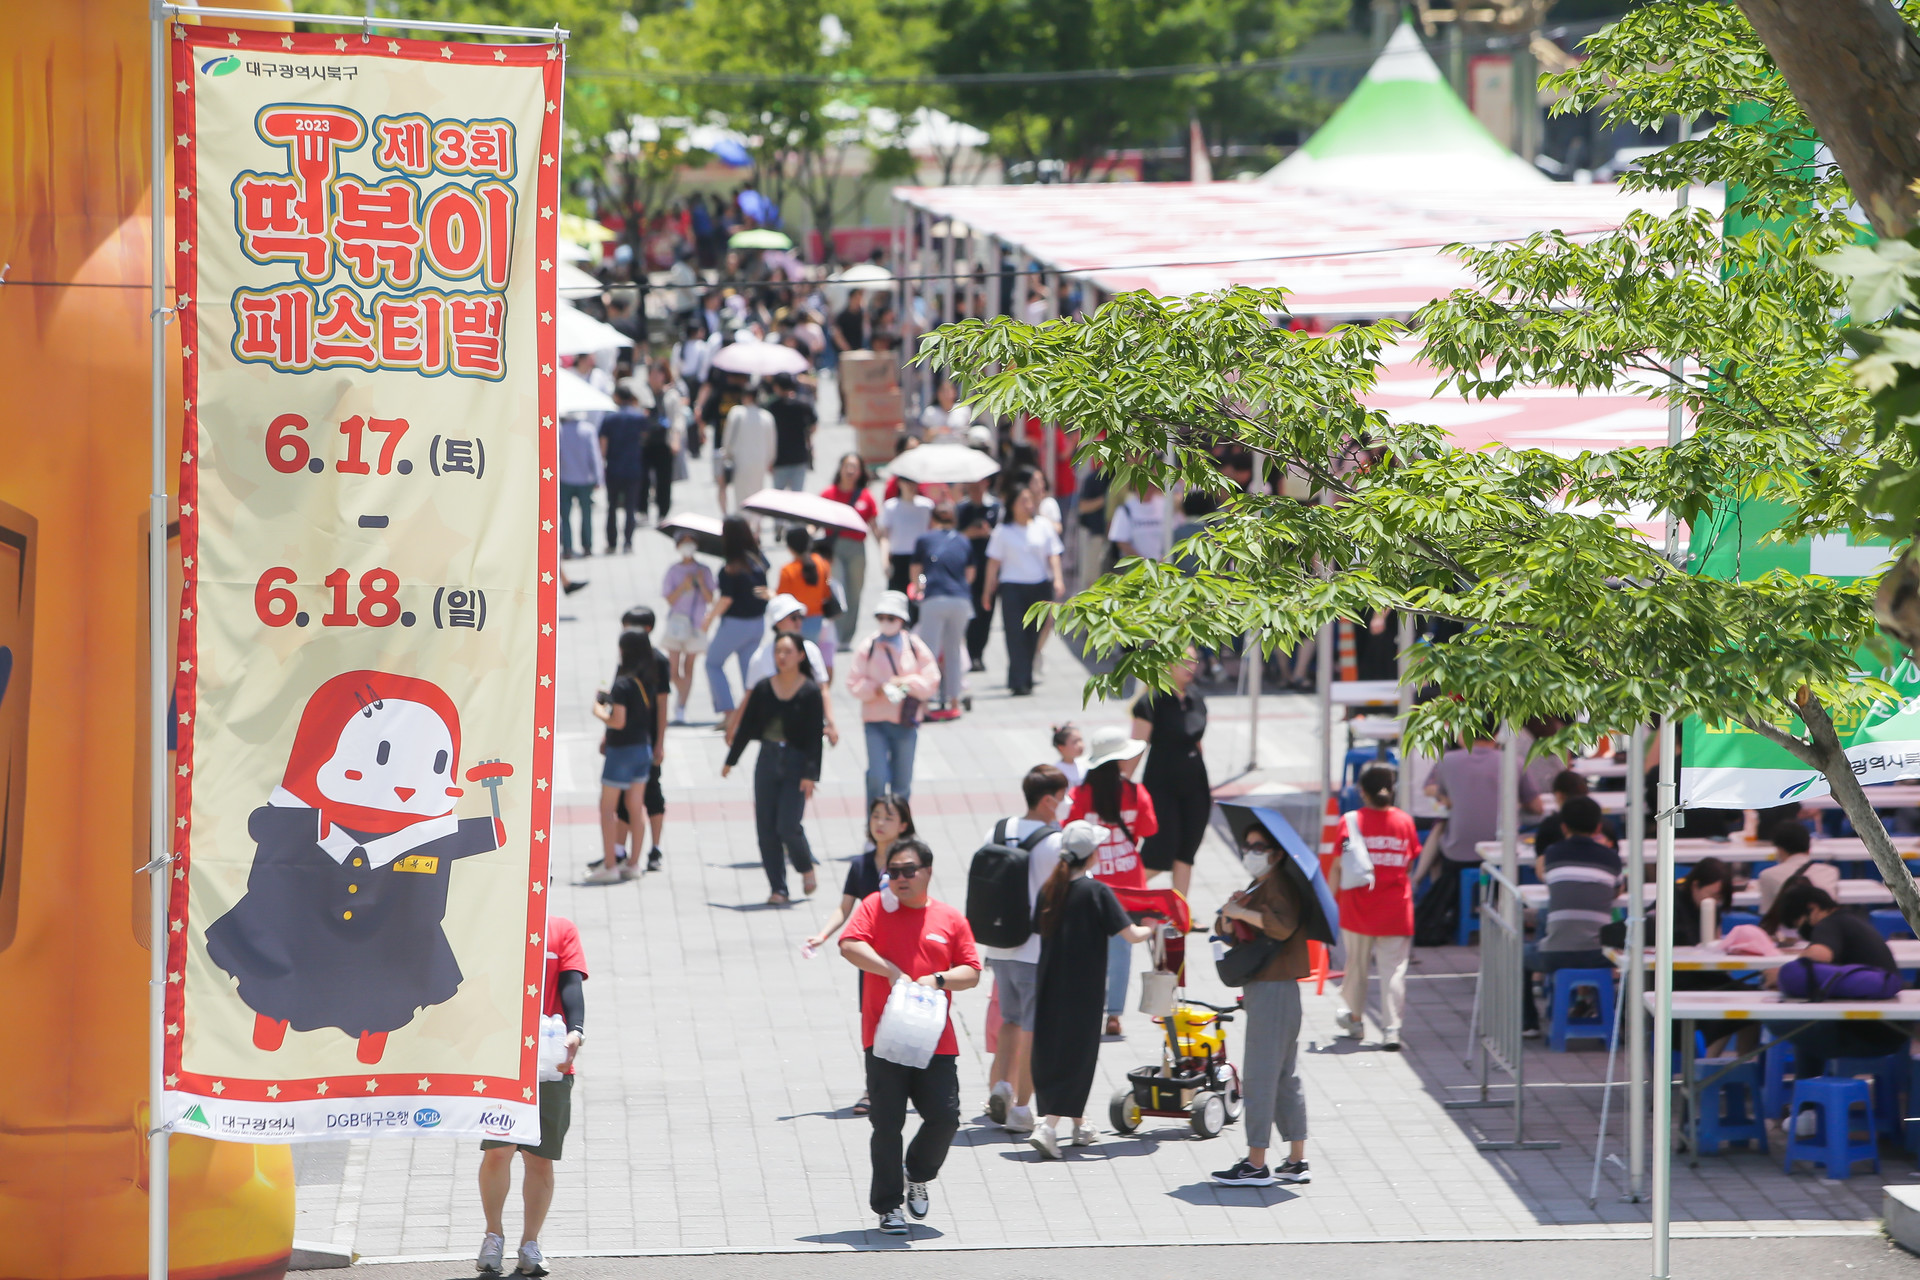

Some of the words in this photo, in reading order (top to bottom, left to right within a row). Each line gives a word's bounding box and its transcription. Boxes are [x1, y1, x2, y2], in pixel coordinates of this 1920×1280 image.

[246, 61, 359, 81] 대구광역시북구
[295, 118, 331, 133] 2023
[240, 135, 511, 287] 떡볶이
[240, 291, 504, 373] 페스티벌
[429, 434, 486, 480] (토)
[432, 586, 487, 631] (일)
[221, 1115, 296, 1131] 대구광역시
[326, 1110, 409, 1128] DGB대구은행
[415, 1111, 440, 1124] DGB
[479, 1112, 516, 1131] Kelly
